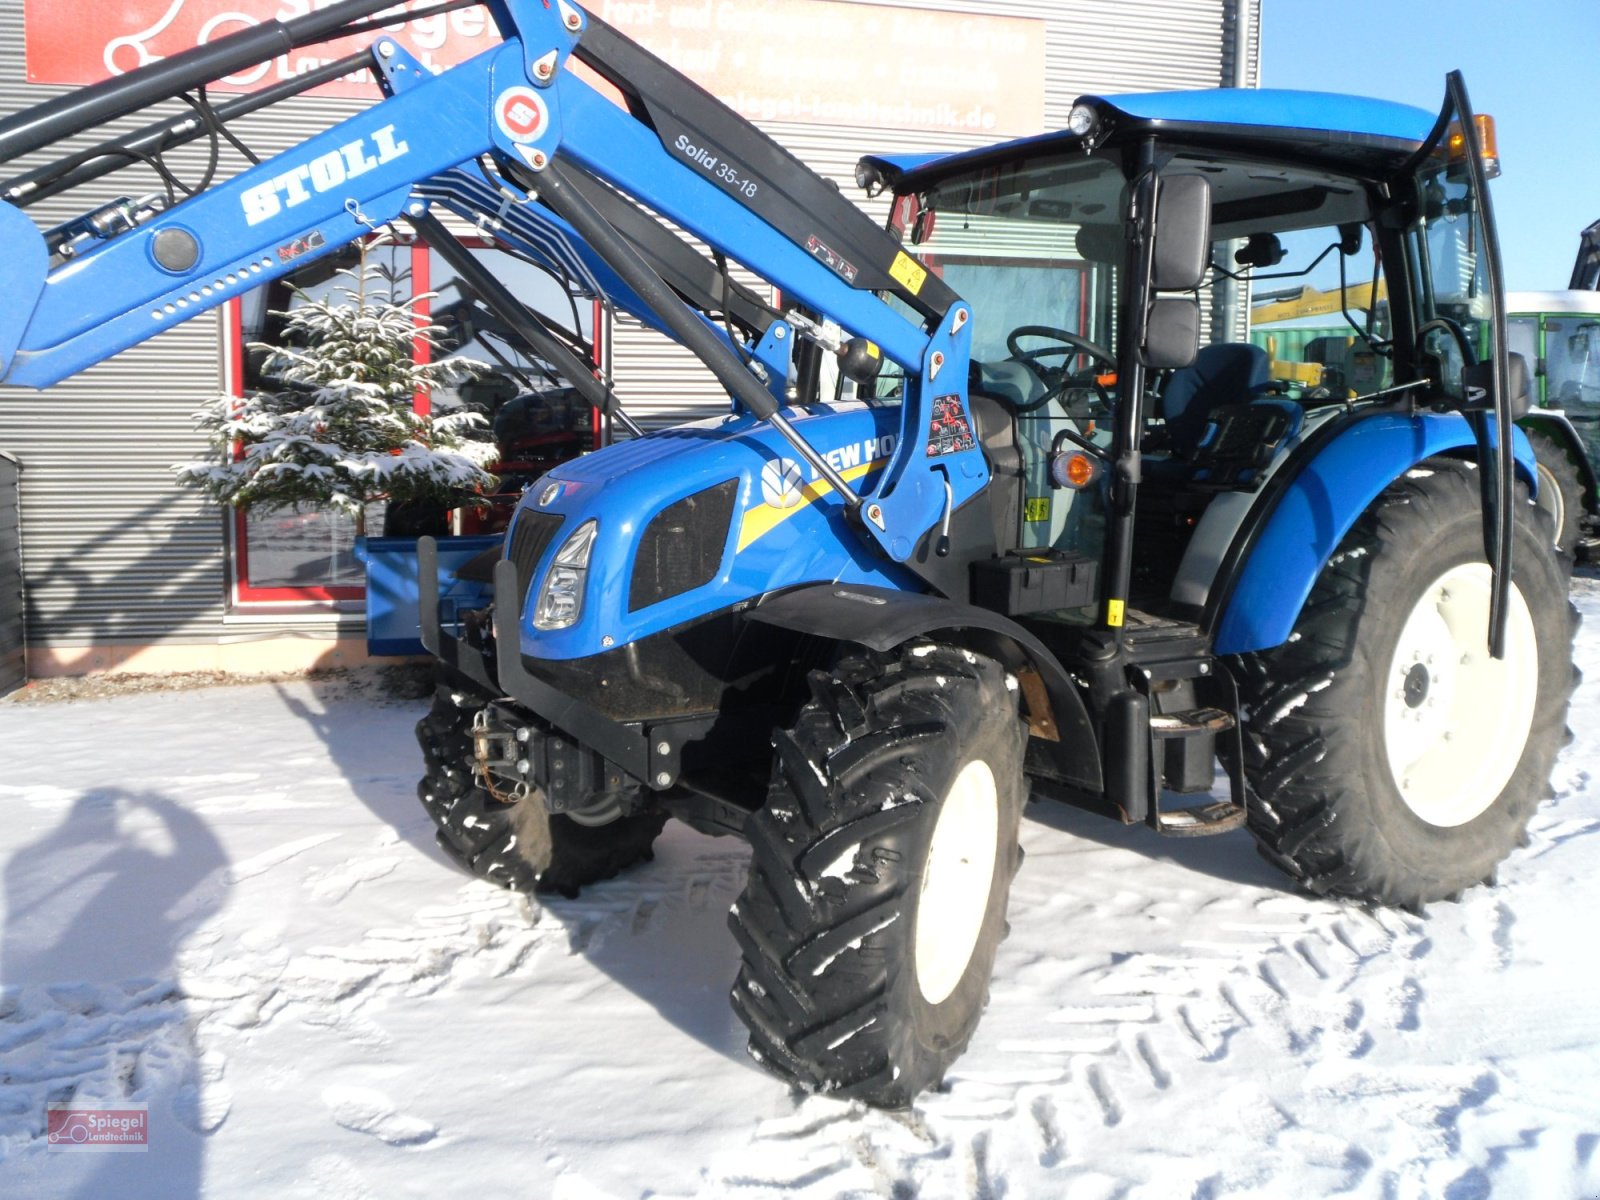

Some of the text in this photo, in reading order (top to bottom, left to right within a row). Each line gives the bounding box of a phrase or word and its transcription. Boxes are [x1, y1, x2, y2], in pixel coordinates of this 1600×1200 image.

[241, 124, 409, 226] STOLL
[675, 135, 757, 197] Solid 35-18
[865, 433, 900, 461] HO
